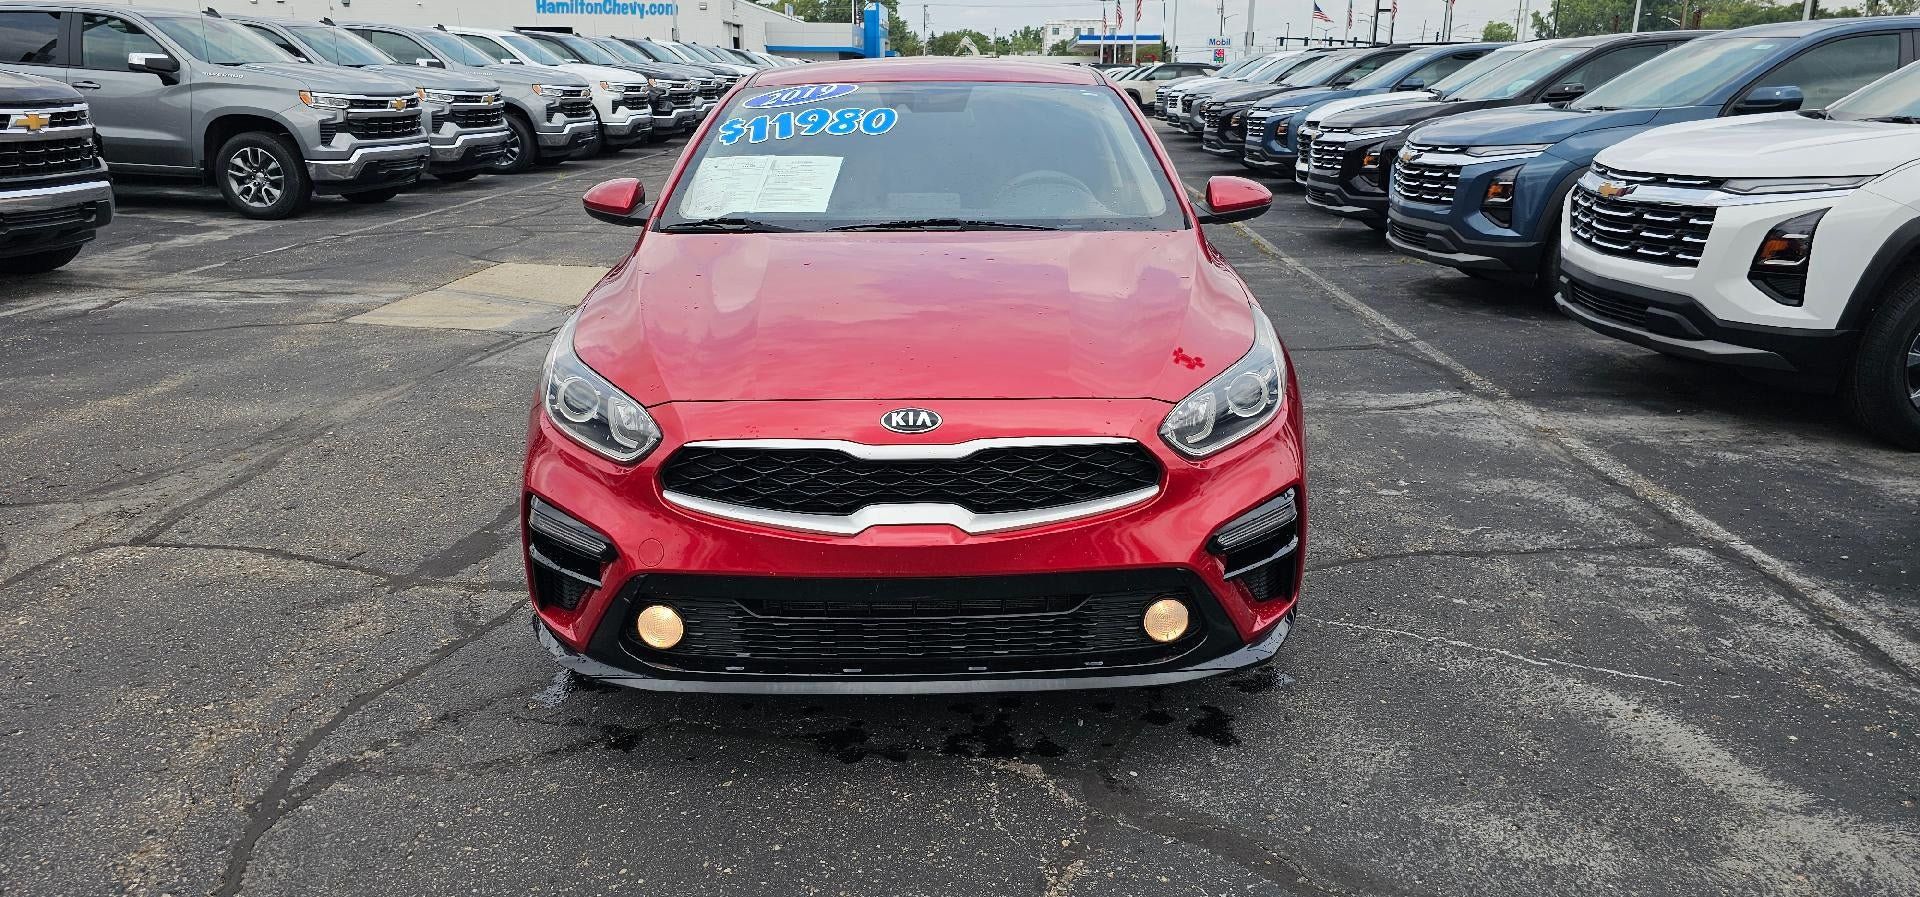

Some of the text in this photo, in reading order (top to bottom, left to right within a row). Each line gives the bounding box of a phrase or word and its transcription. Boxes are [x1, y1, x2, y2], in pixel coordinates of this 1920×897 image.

[536, 0, 679, 19] HamiltonChevy.com
[1208, 38, 1231, 46] Mobil
[763, 84, 838, 106] 2019
[718, 107, 898, 145] $11980
[891, 411, 933, 427] KIA
